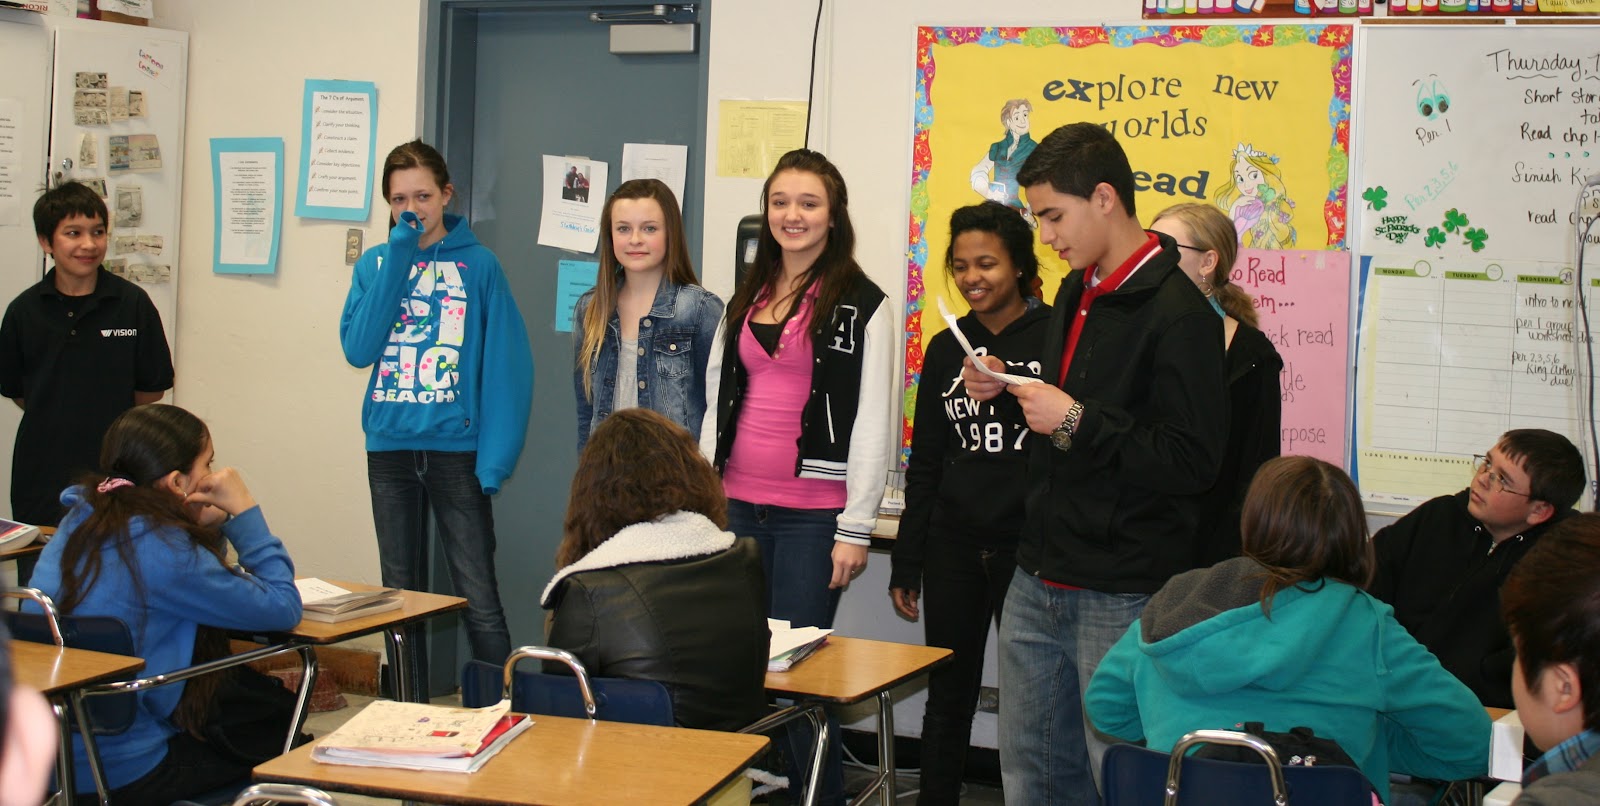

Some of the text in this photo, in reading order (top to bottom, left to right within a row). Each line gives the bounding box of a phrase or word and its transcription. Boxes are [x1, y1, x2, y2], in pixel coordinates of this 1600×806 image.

[1043, 73, 1279, 110] explore new
[1524, 86, 1562, 104] Short
[1521, 122, 1552, 141] Read
[1133, 170, 1210, 200] ead
[1528, 209, 1557, 224] read
[1246, 255, 1286, 288] Read
[1382, 268, 1406, 276] MONDAY
[1525, 292, 1547, 308] intro
[1551, 296, 1559, 308] to
[1267, 322, 1334, 348] ick read
[372, 389, 456, 404] BEACH
[944, 397, 980, 421] NEW
[954, 422, 1030, 453] 1987
[1281, 427, 1327, 451] rpose
